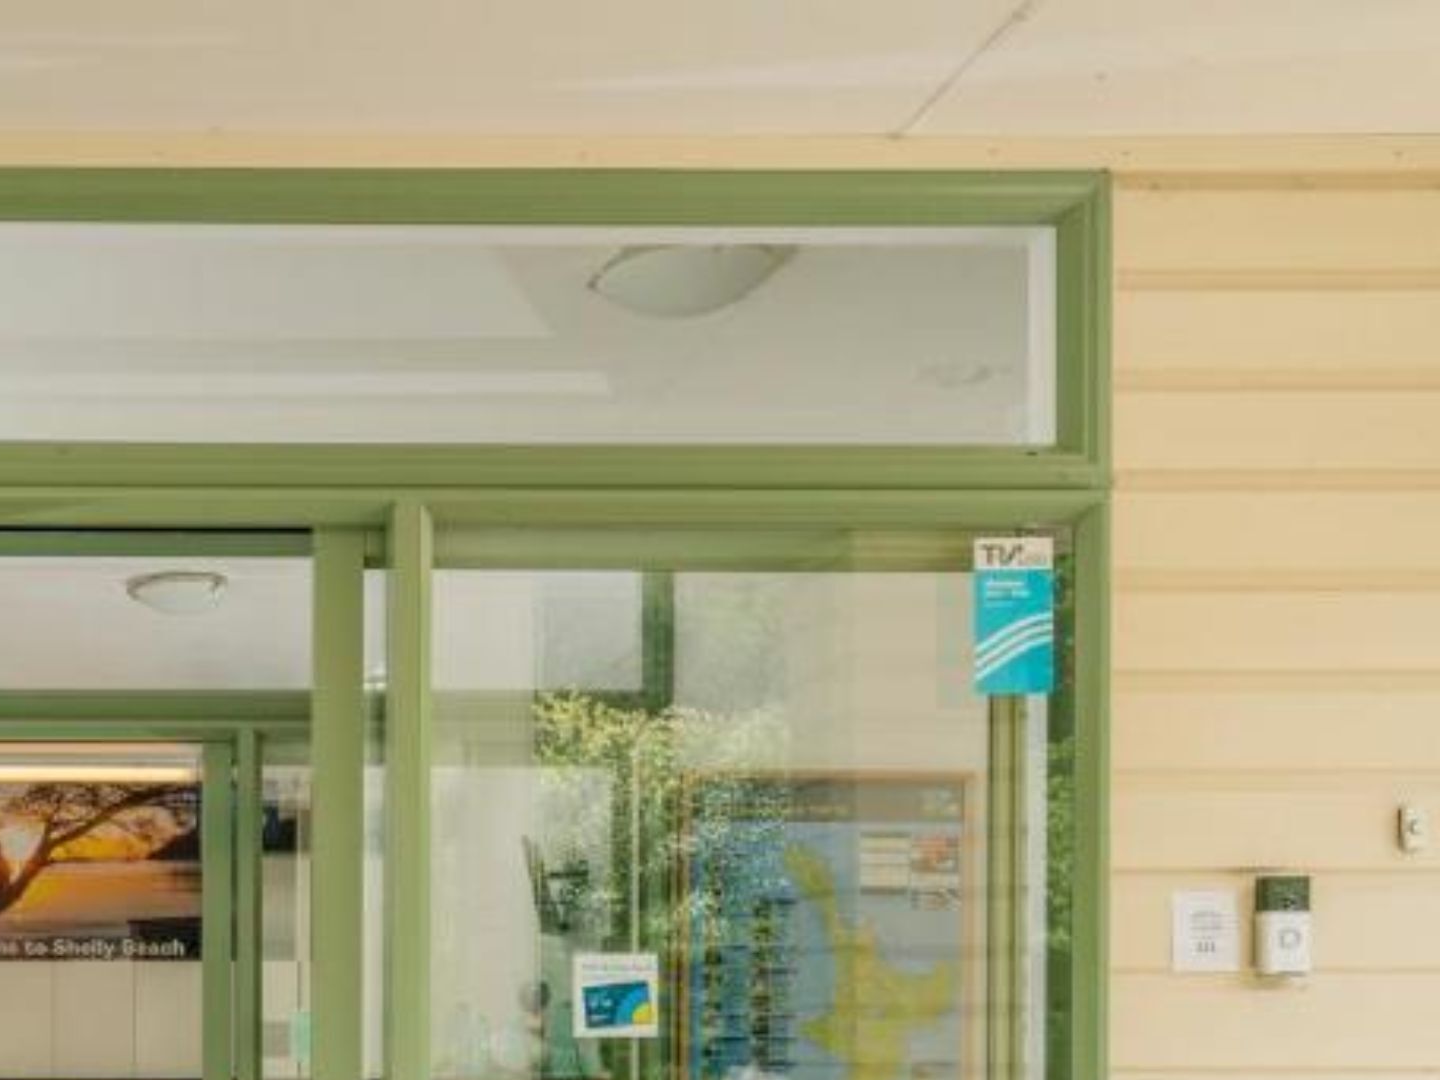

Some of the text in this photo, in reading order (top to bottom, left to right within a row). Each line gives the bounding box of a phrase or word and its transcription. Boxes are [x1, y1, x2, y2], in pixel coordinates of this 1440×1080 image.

[25, 938, 48, 955] to
[53, 937, 114, 958] Shelly
[122, 937, 185, 957] Beach
